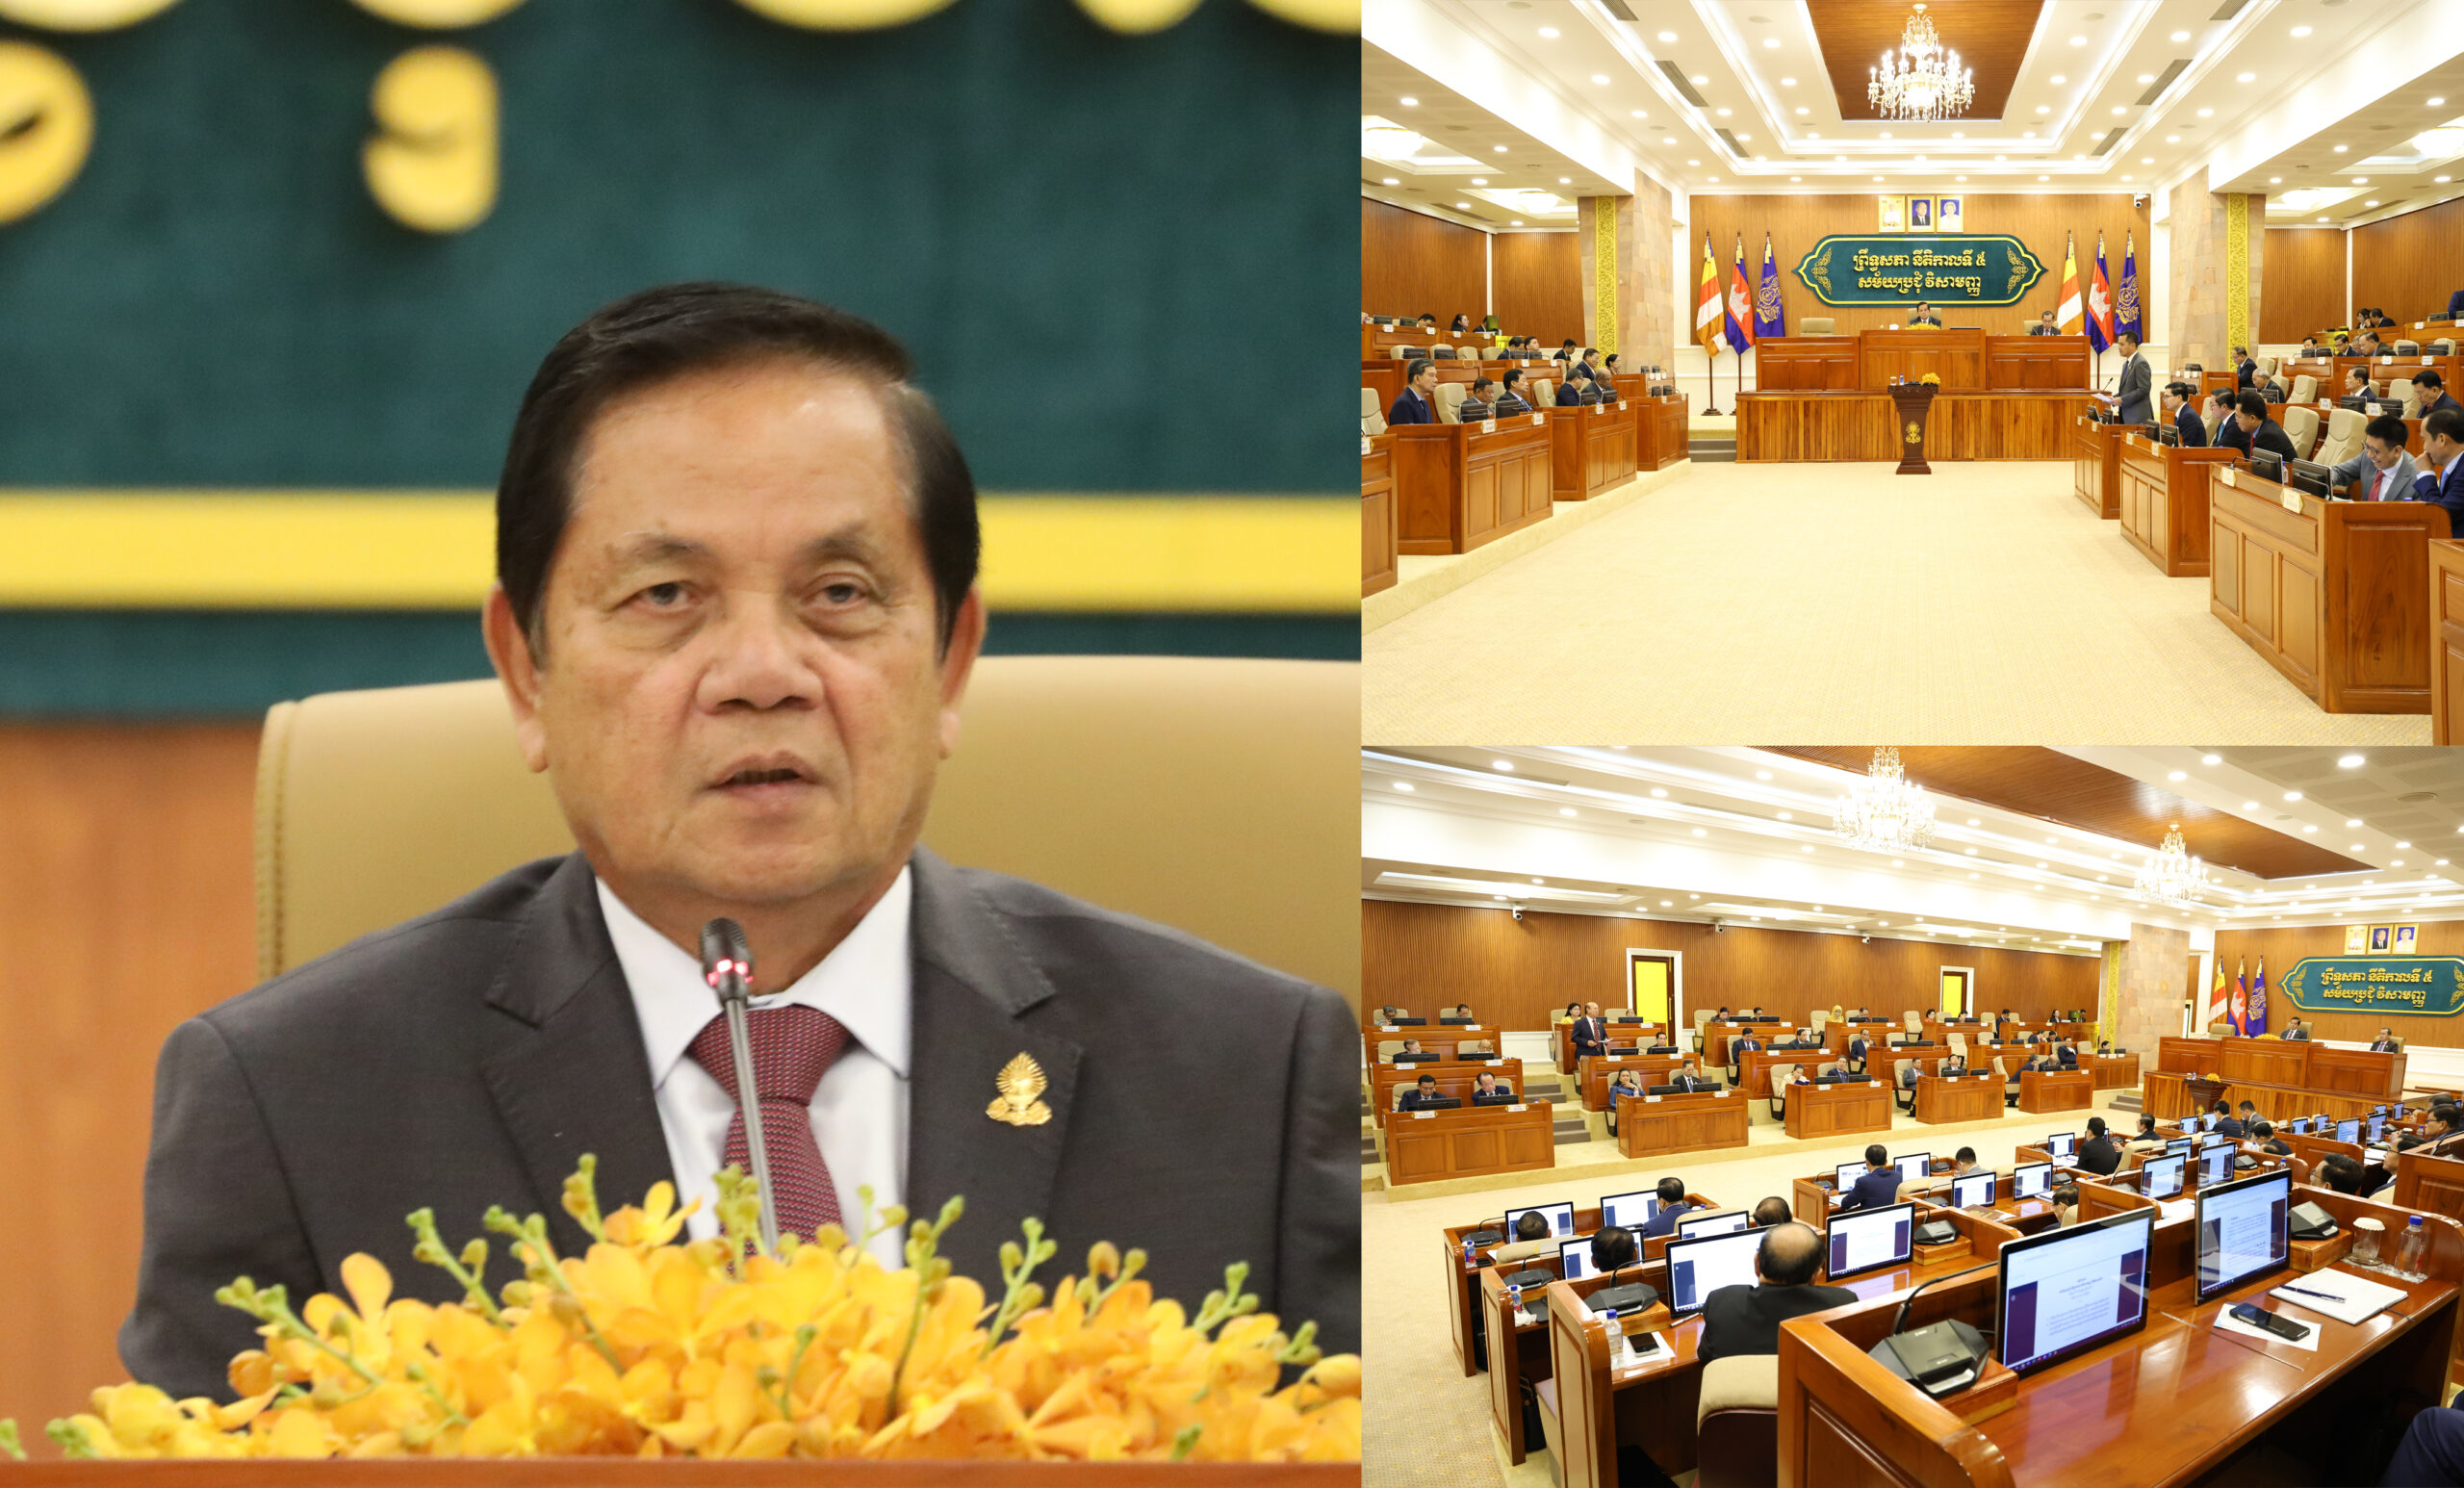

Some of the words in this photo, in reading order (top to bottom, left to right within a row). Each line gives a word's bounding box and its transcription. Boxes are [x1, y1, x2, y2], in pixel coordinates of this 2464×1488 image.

[1853, 248, 1910, 271] ព្រឹទ្ធសភា
[1912, 248, 1973, 267] នីតិកាលទី
[1976, 251, 1987, 267] ៥
[1859, 270, 1922, 294] សម័យប្រជុំ
[1925, 271, 1982, 296] វិសាមញ្ញ
[2423, 969, 2433, 983] ៥
